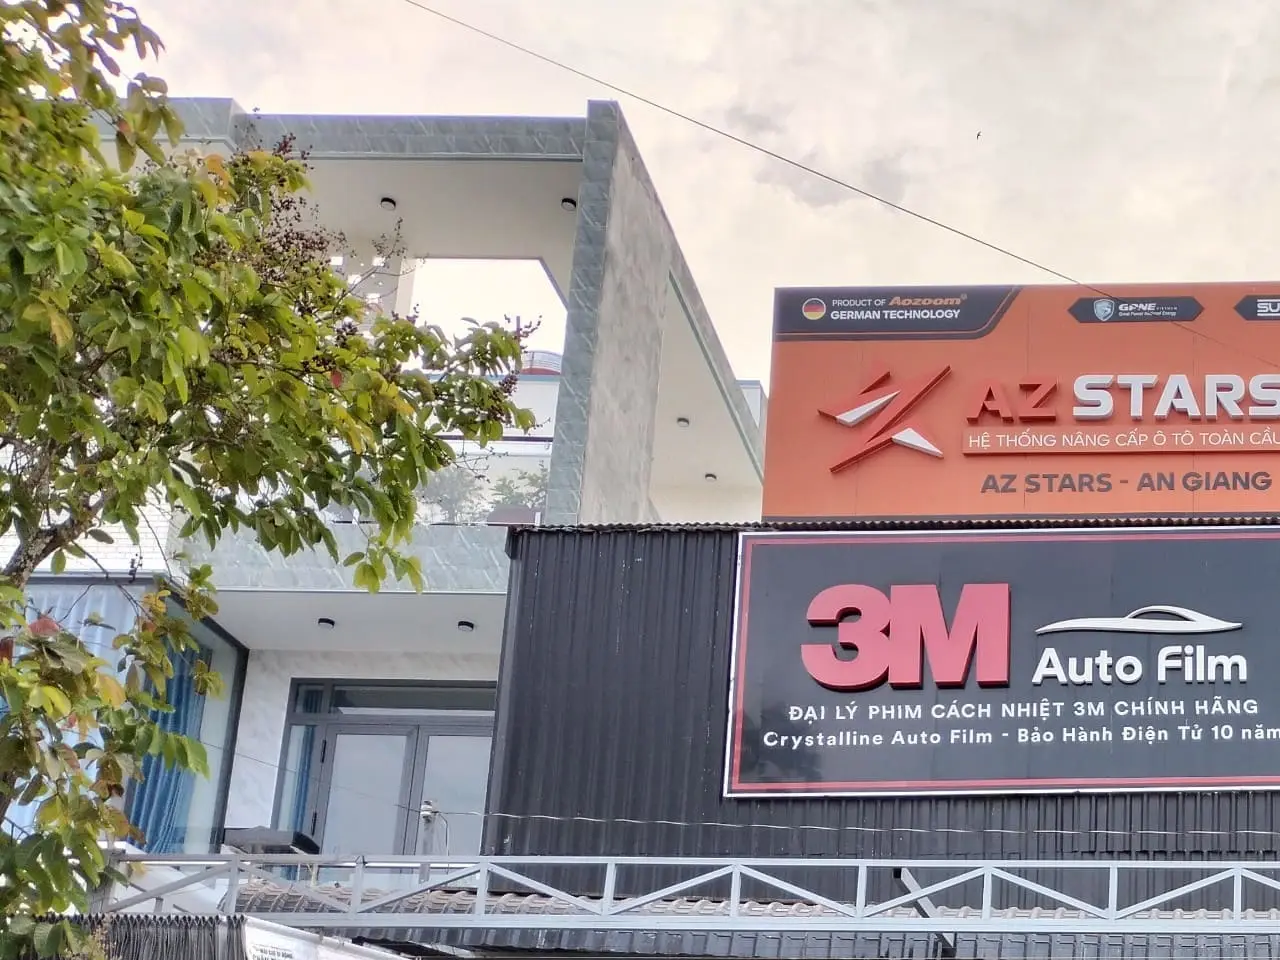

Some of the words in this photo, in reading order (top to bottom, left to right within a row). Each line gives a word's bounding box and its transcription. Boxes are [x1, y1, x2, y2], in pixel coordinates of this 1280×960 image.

[830, 310, 881, 320] GERMAN
[882, 308, 961, 320] TECHNOLOGY
[831, 298, 872, 307] PRODUCT
[874, 298, 887, 307] OF
[966, 376, 1060, 422] AZ
[968, 433, 991, 449] HỆ
[996, 427, 1058, 448] THỐNG
[1062, 431, 1111, 447] NÂNG
[1115, 427, 1149, 447] CẤP
[1152, 430, 1167, 446] Ô
[1171, 430, 1195, 446] TÔ
[1199, 429, 1245, 446] TOÀN
[980, 474, 1018, 493] AZ
[1024, 472, 1113, 493] STARS
[1137, 471, 1175, 491] AN
[1181, 470, 1273, 491] GIANG
[800, 582, 1012, 691] 3M
[1031, 646, 1144, 686] Auto
[1156, 643, 1248, 685] Film
[788, 704, 826, 725] ĐẠI
[835, 700, 859, 720] LÝ
[868, 704, 922, 720] PHIM
[931, 699, 992, 719] CÁCH
[1001, 697, 1065, 721] NHIỆT
[1073, 701, 1105, 717] 3M
[1114, 697, 1185, 716] CHÍNH
[1195, 696, 1259, 715] HÃNG
[763, 730, 884, 750] Crystalline
[891, 729, 942, 746] Auto
[950, 728, 993, 745] Film
[1017, 725, 1055, 743] Bảo
[1062, 726, 1113, 743] Hành
[1121, 725, 1169, 745] Điện
[1177, 723, 1203, 741] Tử
[1211, 724, 1234, 740] 10
